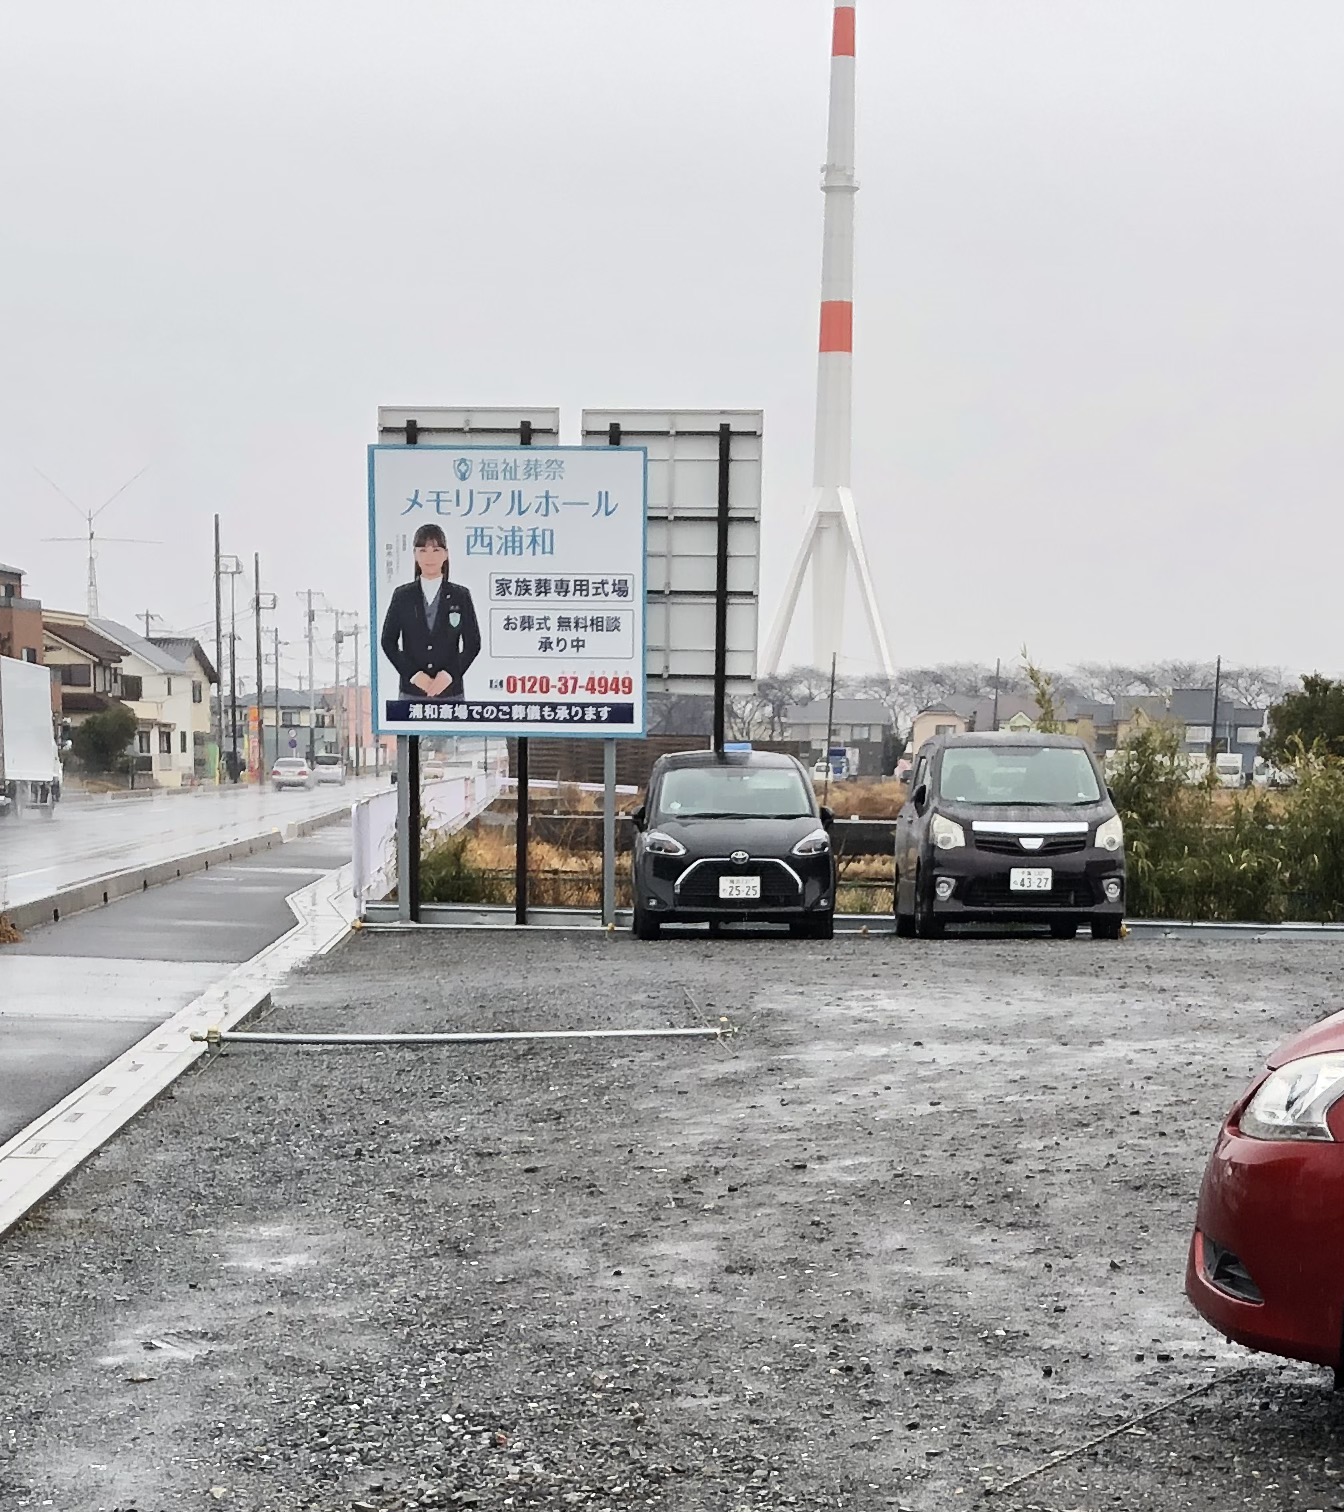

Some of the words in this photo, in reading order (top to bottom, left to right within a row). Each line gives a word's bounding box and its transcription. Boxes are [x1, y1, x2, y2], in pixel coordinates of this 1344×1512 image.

[478, 458, 565, 481] 福祉葬祭
[400, 488, 619, 517] メモリアルホール
[465, 525, 555, 556] 西浦和
[494, 577, 629, 598] 家族葬専用式場
[502, 615, 551, 632] お葬式
[556, 615, 622, 633] 無料相談
[537, 636, 586, 653] 承り中
[506, 675, 633, 695] 0120-37-4949
[728, 885, 758, 896] 25-25
[1019, 877, 1050, 888] 43-27
